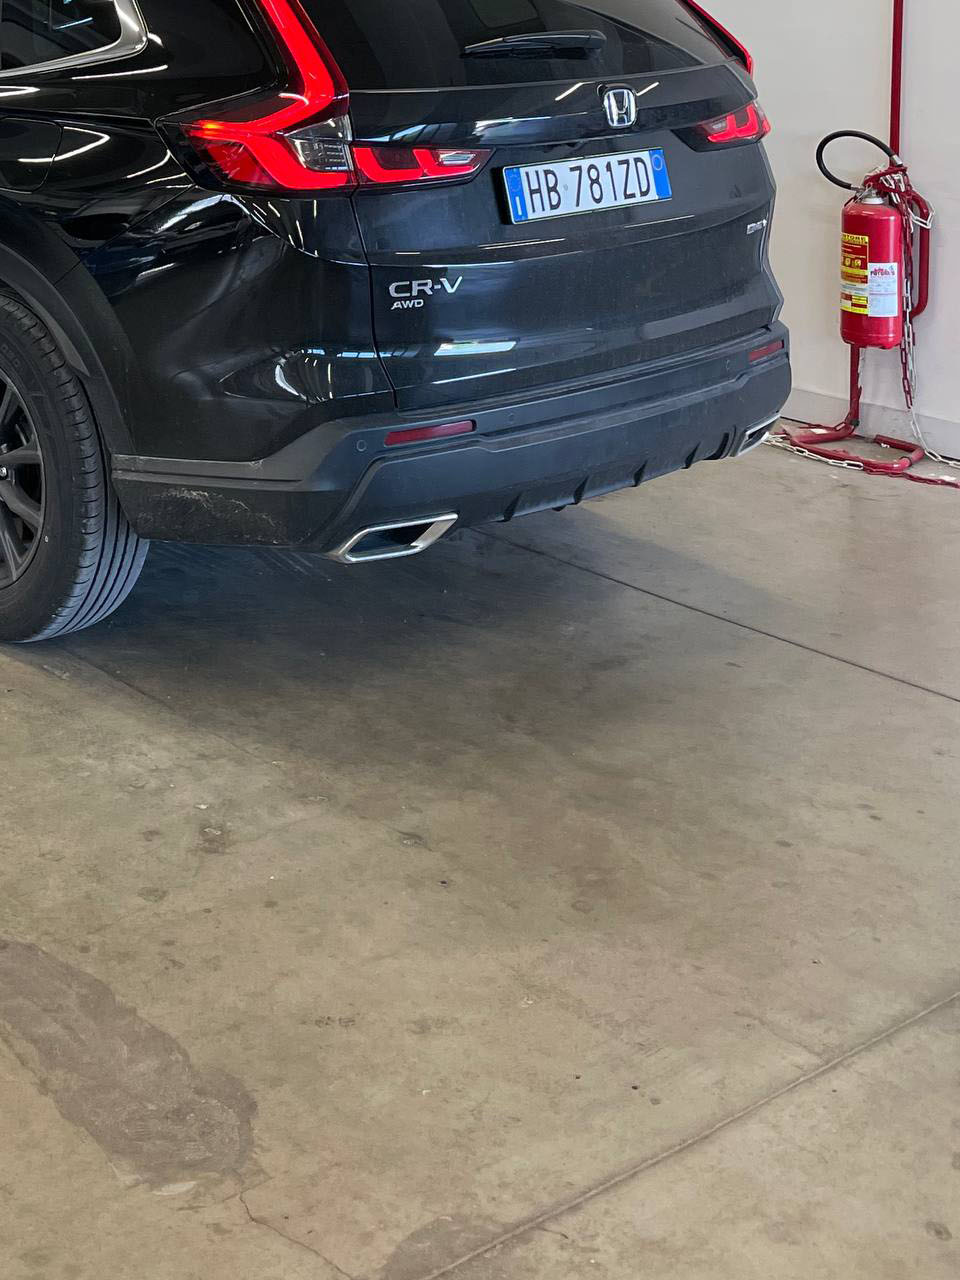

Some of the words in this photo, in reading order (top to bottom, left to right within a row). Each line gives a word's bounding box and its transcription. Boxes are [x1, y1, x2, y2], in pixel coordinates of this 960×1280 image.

[525, 168, 562, 213] HB
[569, 156, 651, 208] 781ZD
[388, 275, 463, 298] CR-V
[390, 299, 424, 311] AWD
